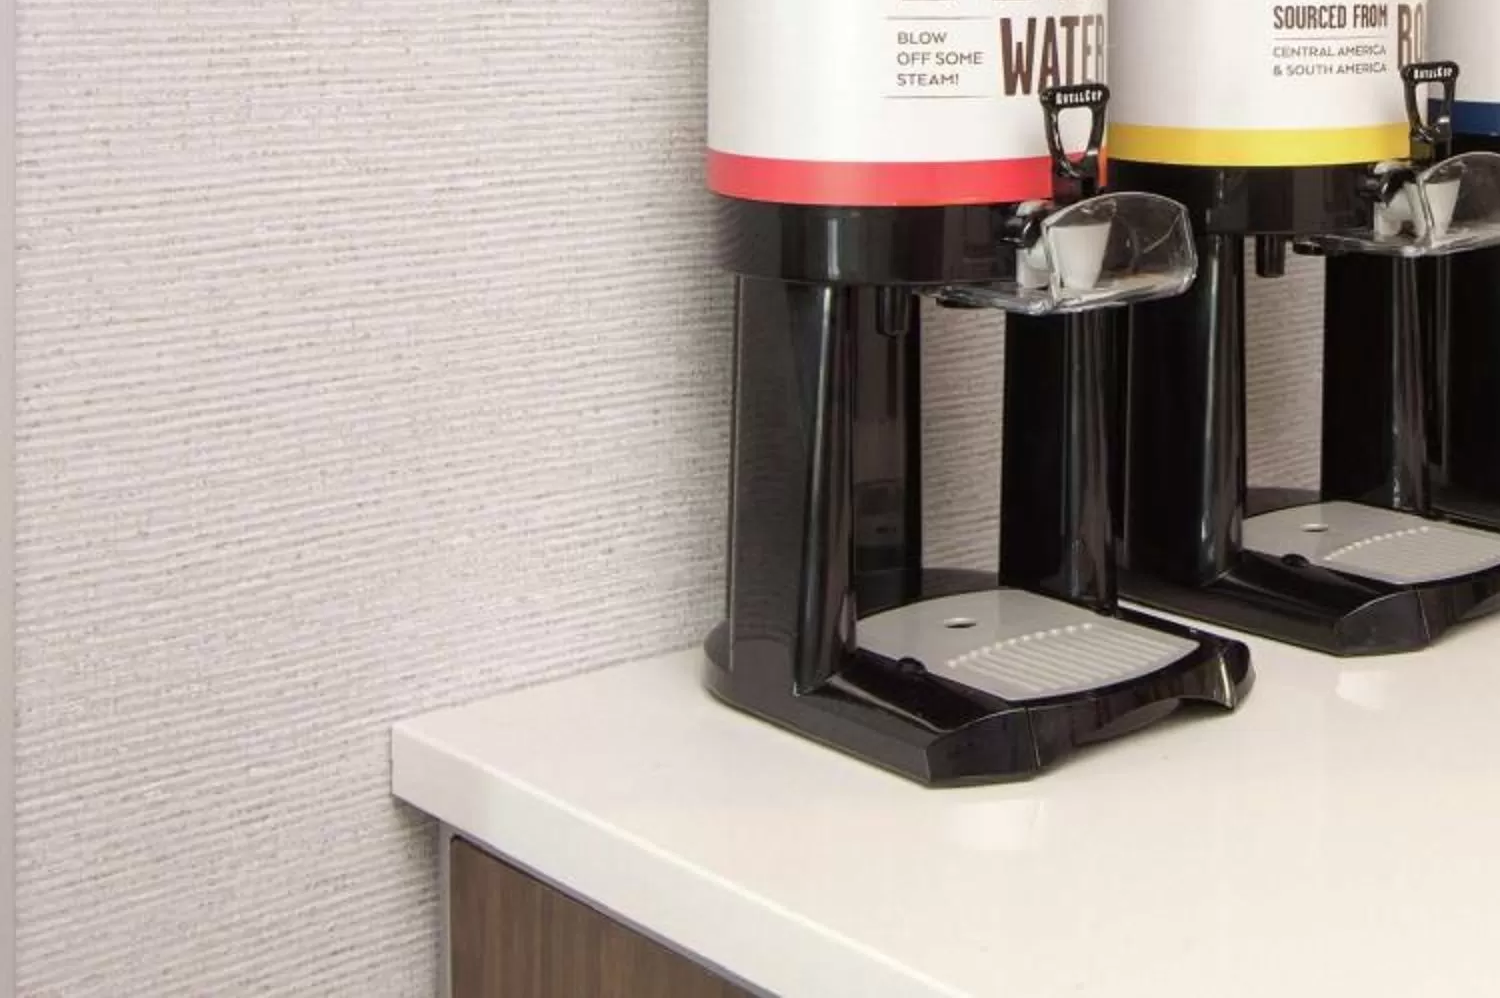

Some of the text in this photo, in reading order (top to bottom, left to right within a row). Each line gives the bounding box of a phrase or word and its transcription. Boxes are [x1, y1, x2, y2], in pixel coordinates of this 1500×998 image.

[1273, 3, 1388, 30] SOURCED FROM
[897, 31, 948, 46] BLOW
[897, 51, 984, 66] OFF SOME
[1000, 14, 1104, 96] WATER
[1273, 44, 1387, 59] CENTRAL AMERICA
[1273, 61, 1388, 77] & SOUTH AMERICA
[897, 73, 960, 87] STEAM!
